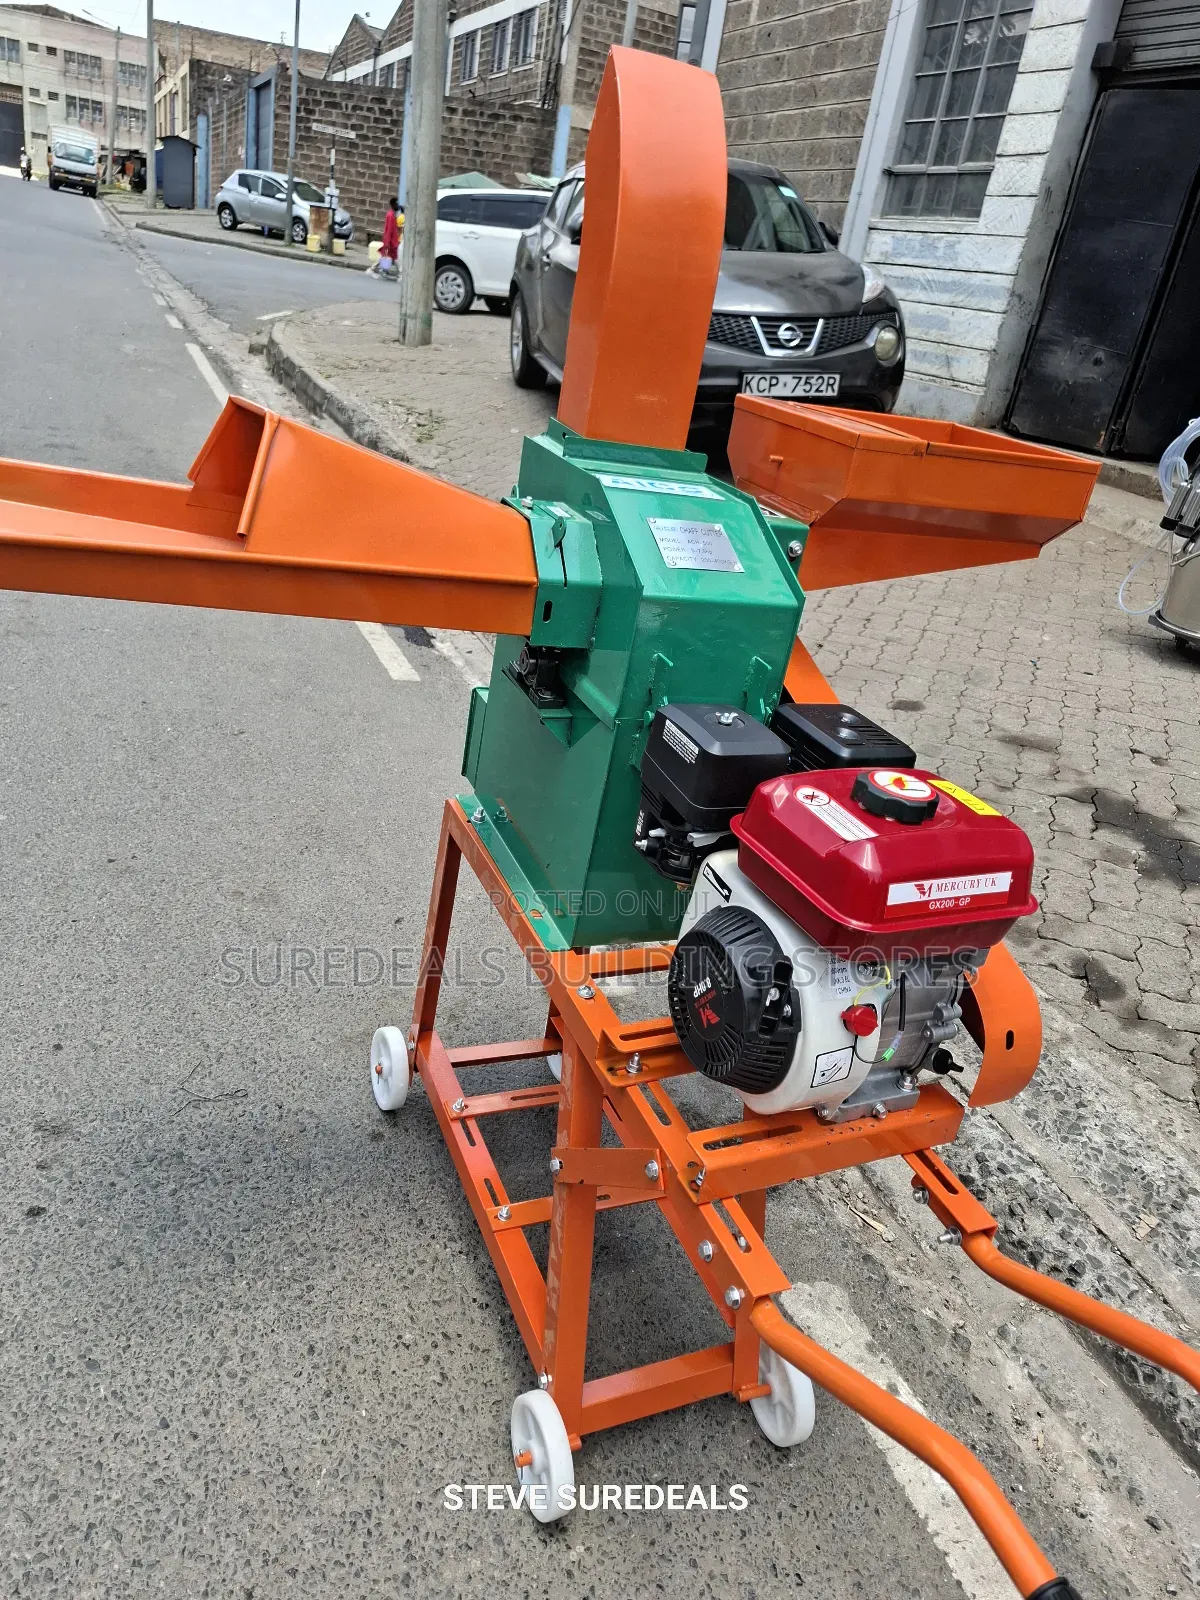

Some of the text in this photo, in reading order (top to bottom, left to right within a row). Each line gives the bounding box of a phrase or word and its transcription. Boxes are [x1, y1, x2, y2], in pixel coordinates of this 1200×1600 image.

[744, 375, 837, 394] KCP 752R
[935, 878, 982, 893] MERCURY
[984, 876, 997, 887] UK
[929, 897, 971, 910] GX200-GP
